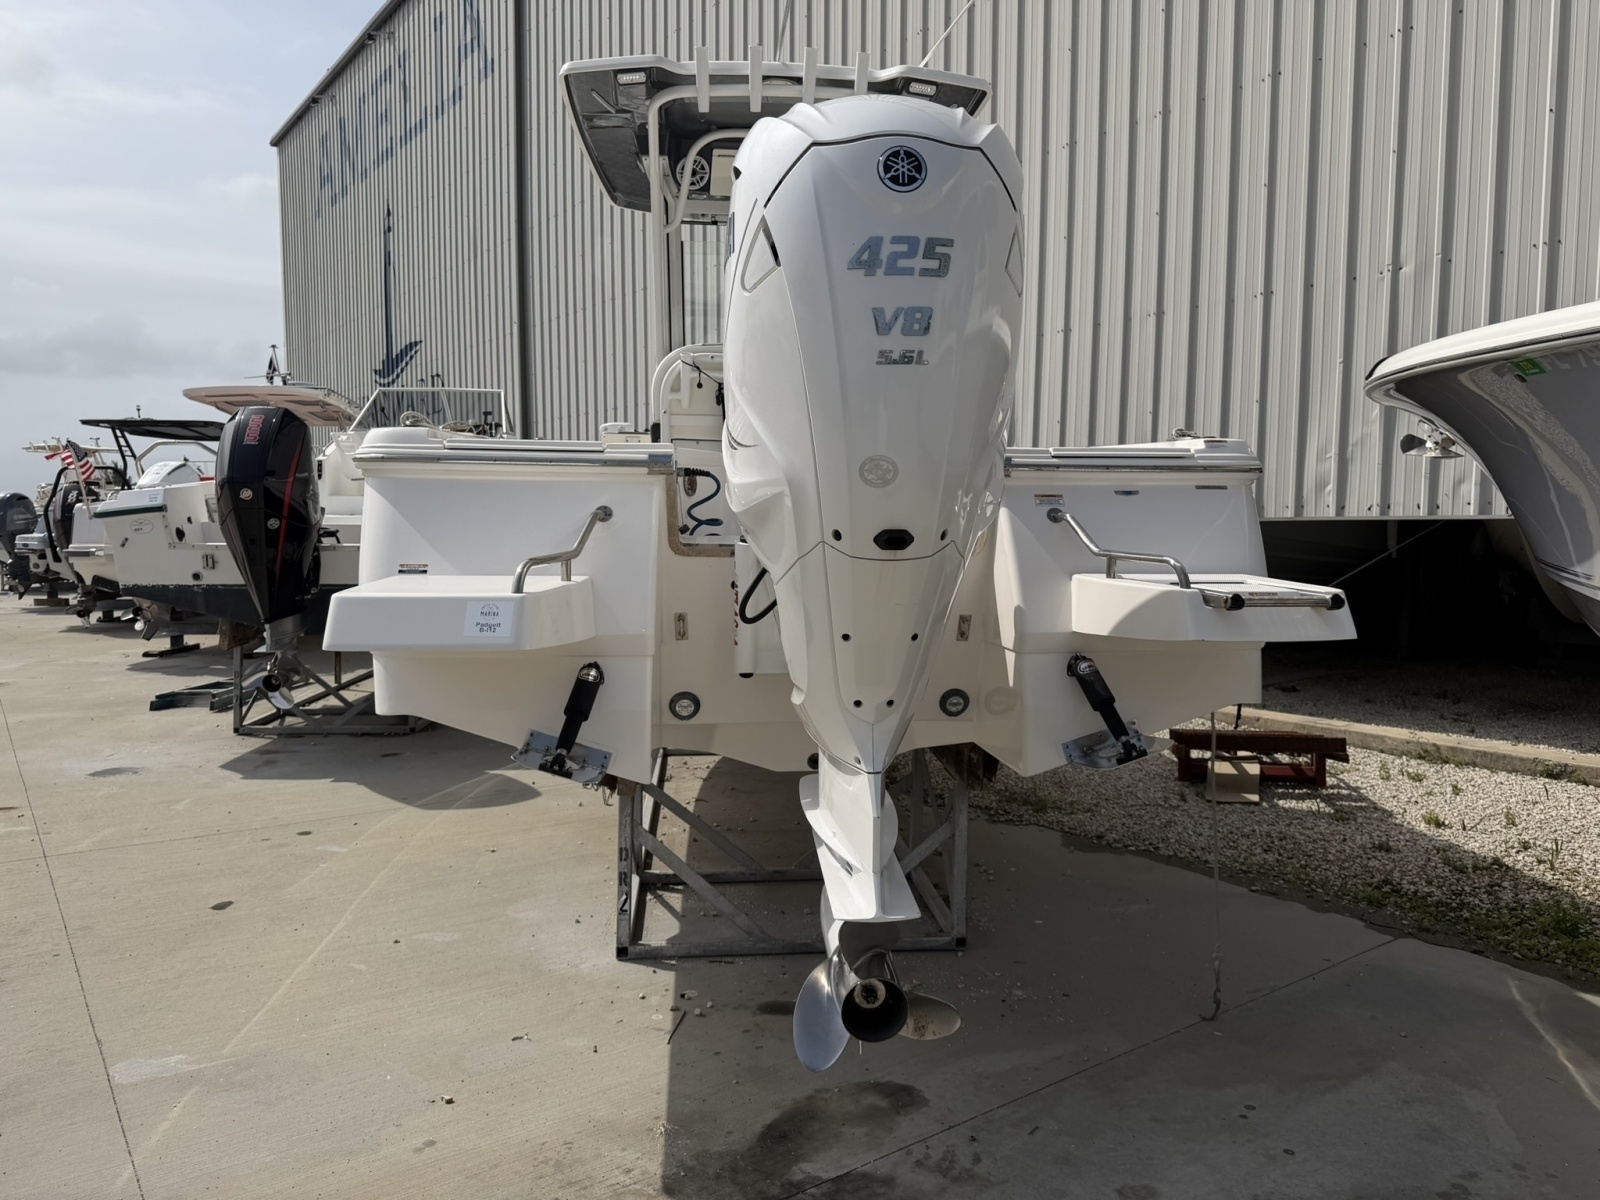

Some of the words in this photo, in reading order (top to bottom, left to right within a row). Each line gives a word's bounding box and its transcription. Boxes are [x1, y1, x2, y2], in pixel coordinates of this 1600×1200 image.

[847, 235, 955, 278] 425
[871, 306, 934, 337] V8
[875, 349, 930, 366] 5.6L
